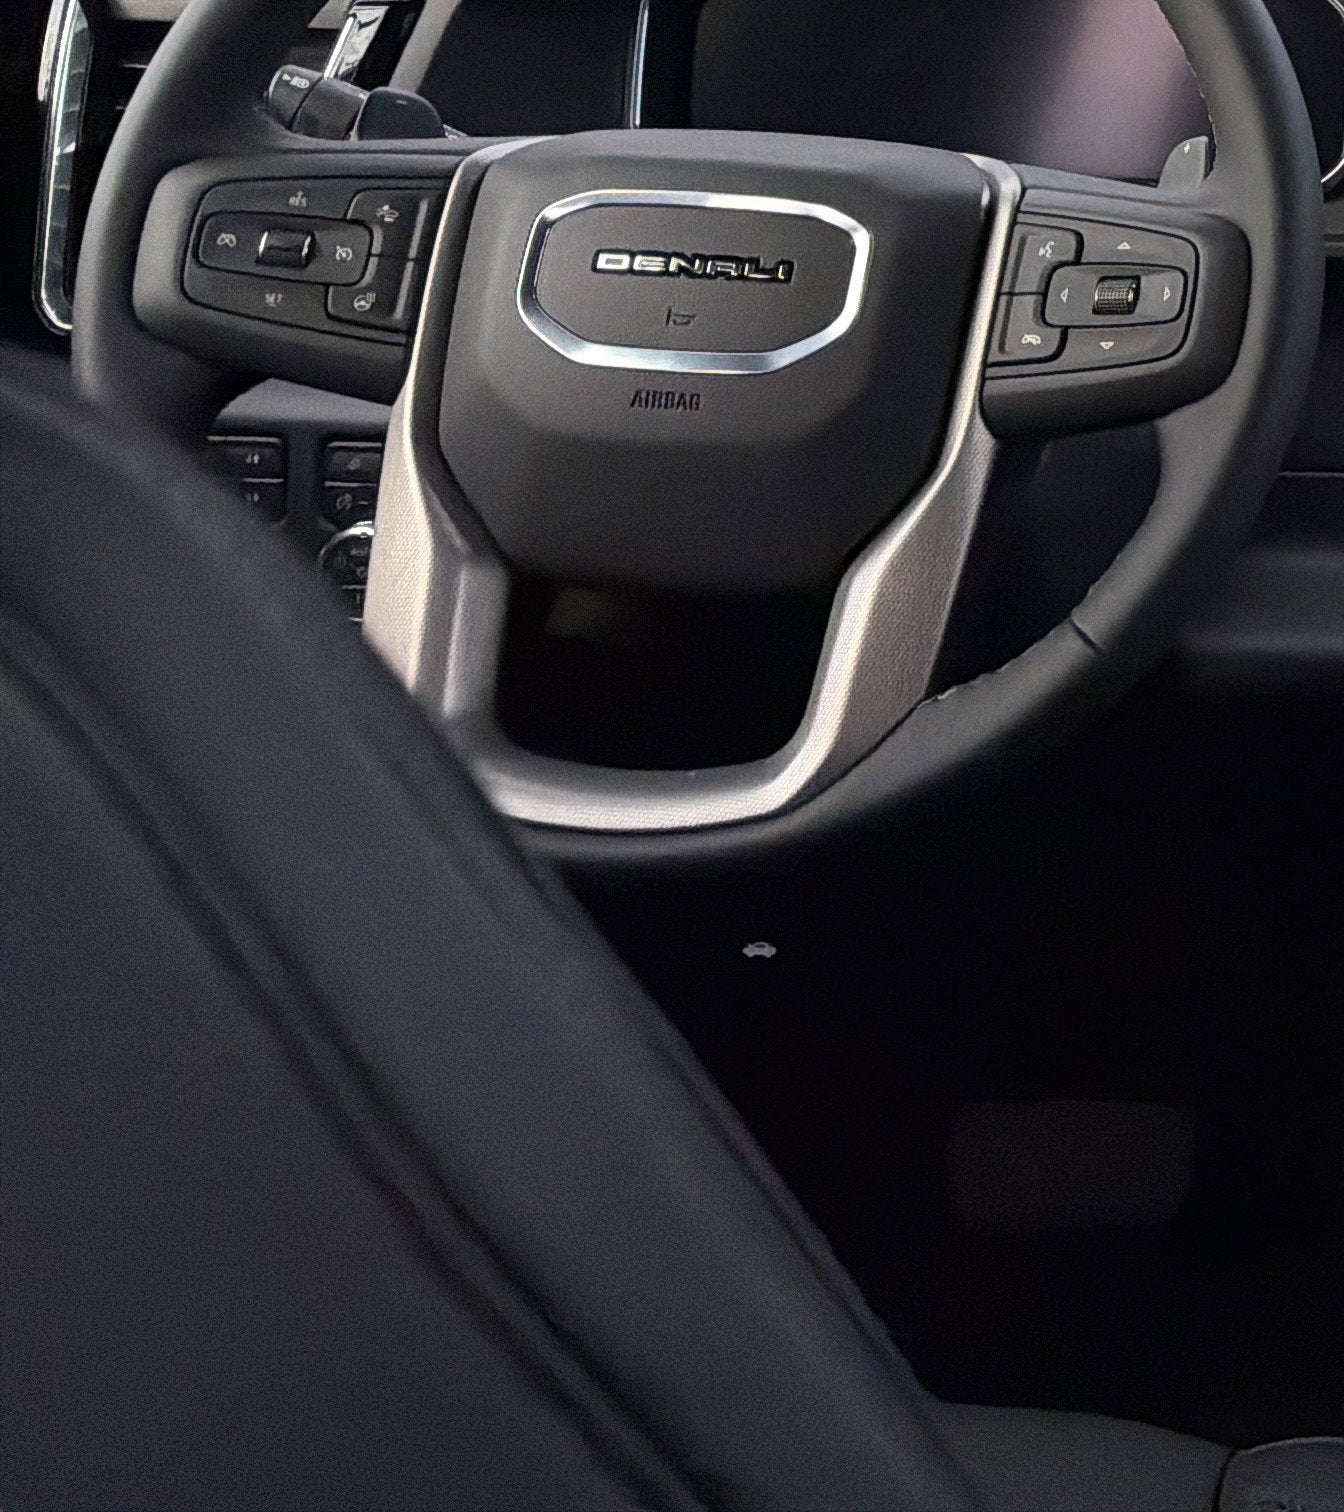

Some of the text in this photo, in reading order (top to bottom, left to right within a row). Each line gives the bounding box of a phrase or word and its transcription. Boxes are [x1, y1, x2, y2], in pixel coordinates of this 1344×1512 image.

[289, 196, 307, 207] RES
[593, 249, 795, 283] DENALI
[265, 293, 283, 303] SET
[630, 390, 700, 411] AIRBAG
